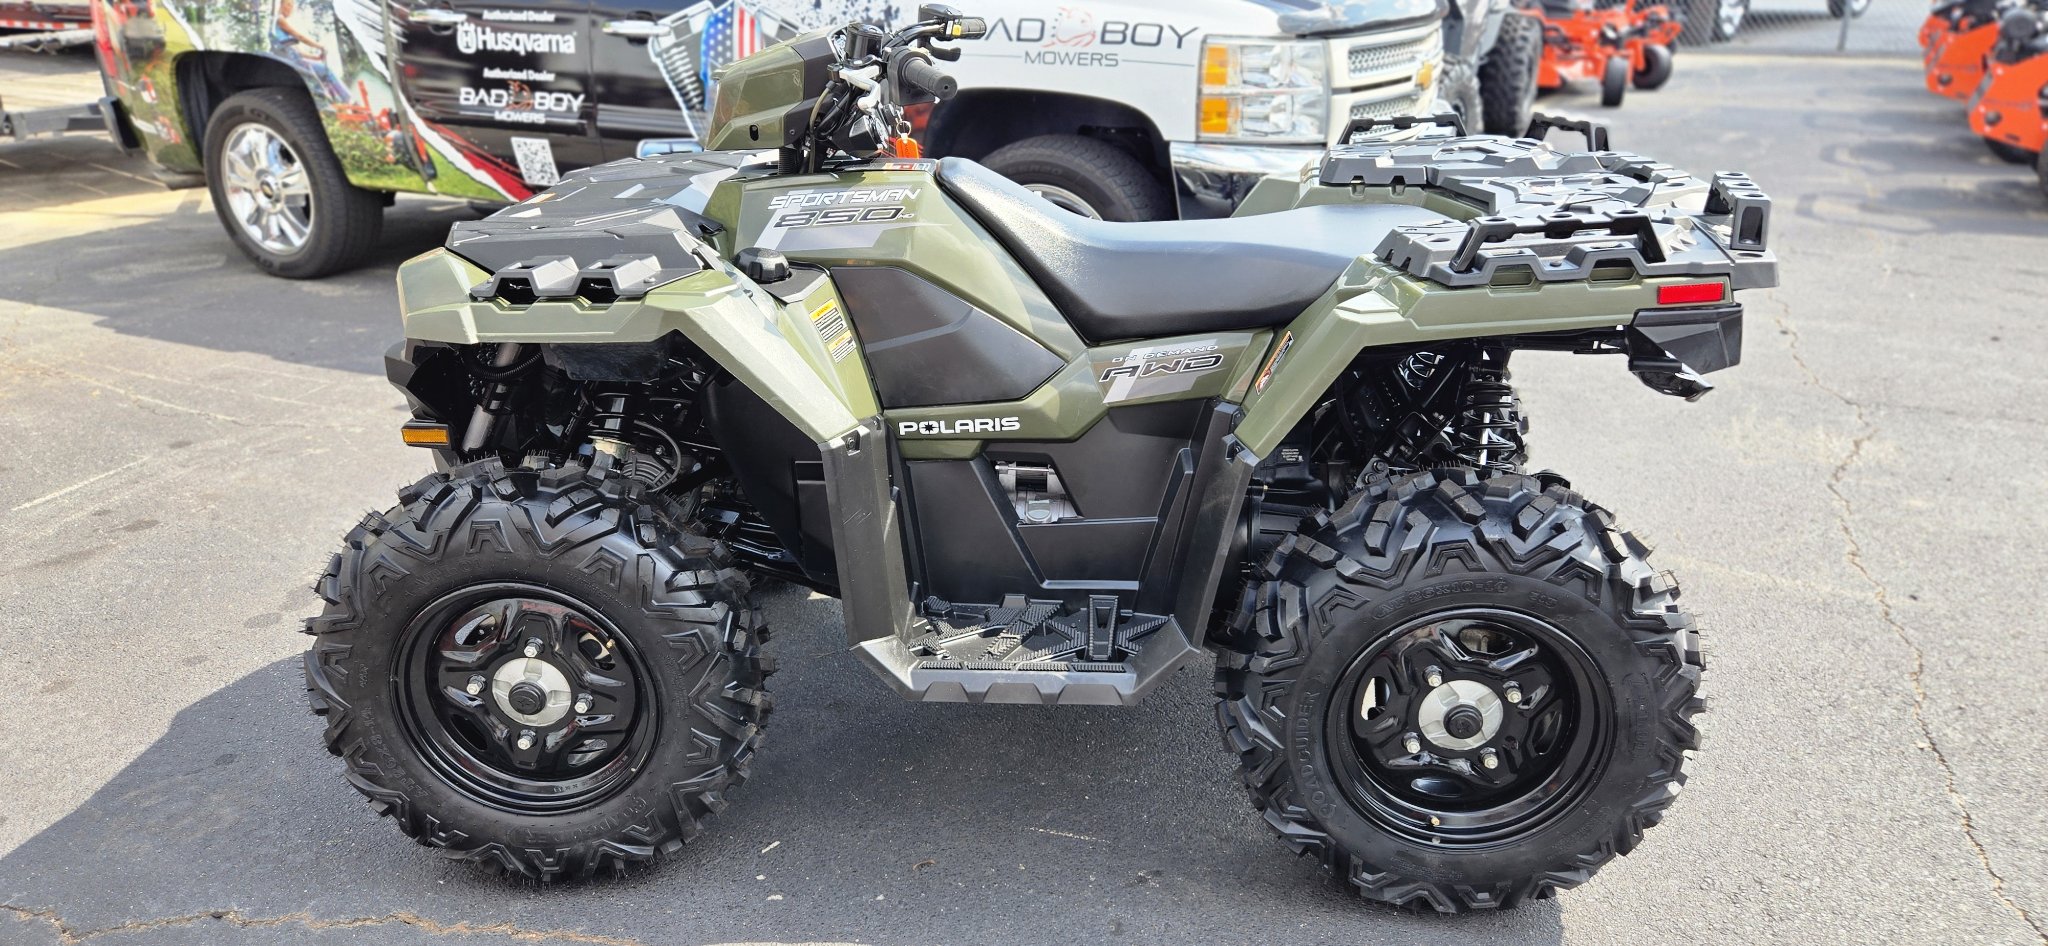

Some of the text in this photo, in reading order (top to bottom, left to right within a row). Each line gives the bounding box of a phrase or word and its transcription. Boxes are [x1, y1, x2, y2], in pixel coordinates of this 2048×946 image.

[528, 10, 556, 22] Dealer
[476, 26, 576, 56] Husqvarna
[984, 17, 1199, 49] AD BOY
[1024, 50, 1119, 67] MOWERS
[528, 69, 556, 82] Dealer
[459, 87, 585, 112] BAD BOY
[494, 110, 546, 124] MOWERS
[767, 188, 922, 210] SPORTSMAN
[772, 206, 905, 229] 850
[1112, 345, 1219, 363] ON DEMAND
[1098, 353, 1225, 383] AWD
[898, 416, 1021, 436] POLARIS
